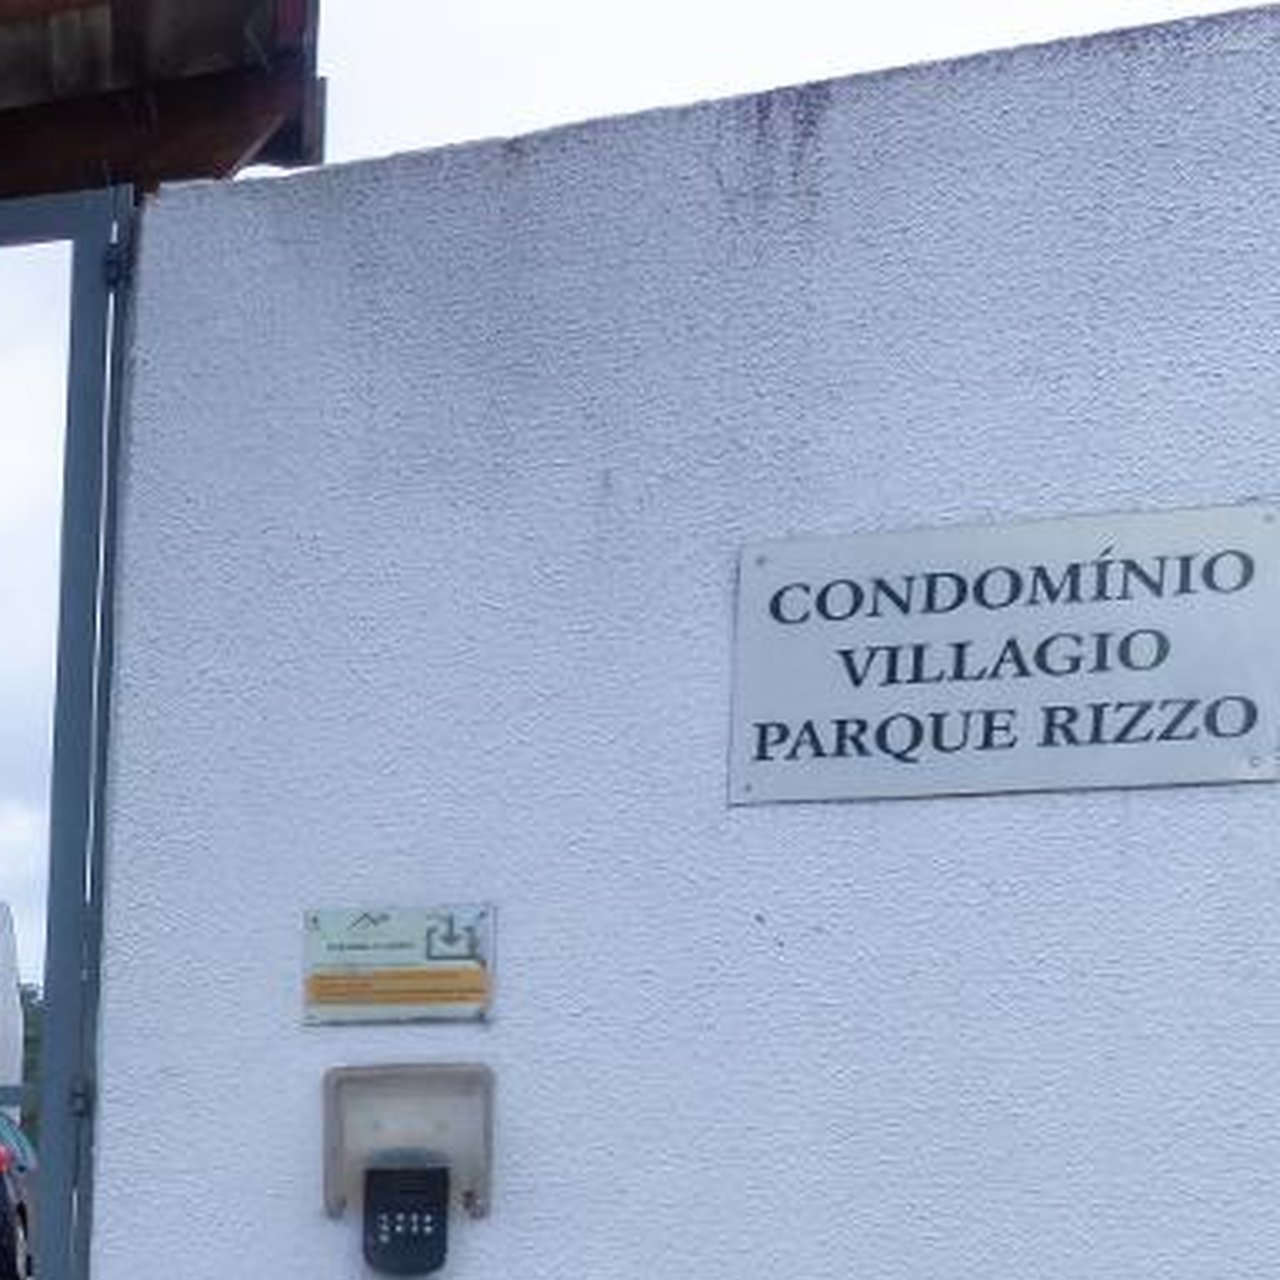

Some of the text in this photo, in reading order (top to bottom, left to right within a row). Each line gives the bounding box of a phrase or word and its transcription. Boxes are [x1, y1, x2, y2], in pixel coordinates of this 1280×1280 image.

[768, 545, 1257, 625] CONDOMÍNIO
[835, 628, 1171, 688] VILLAGIO
[751, 695, 1259, 764] PARQUE RIZZO
